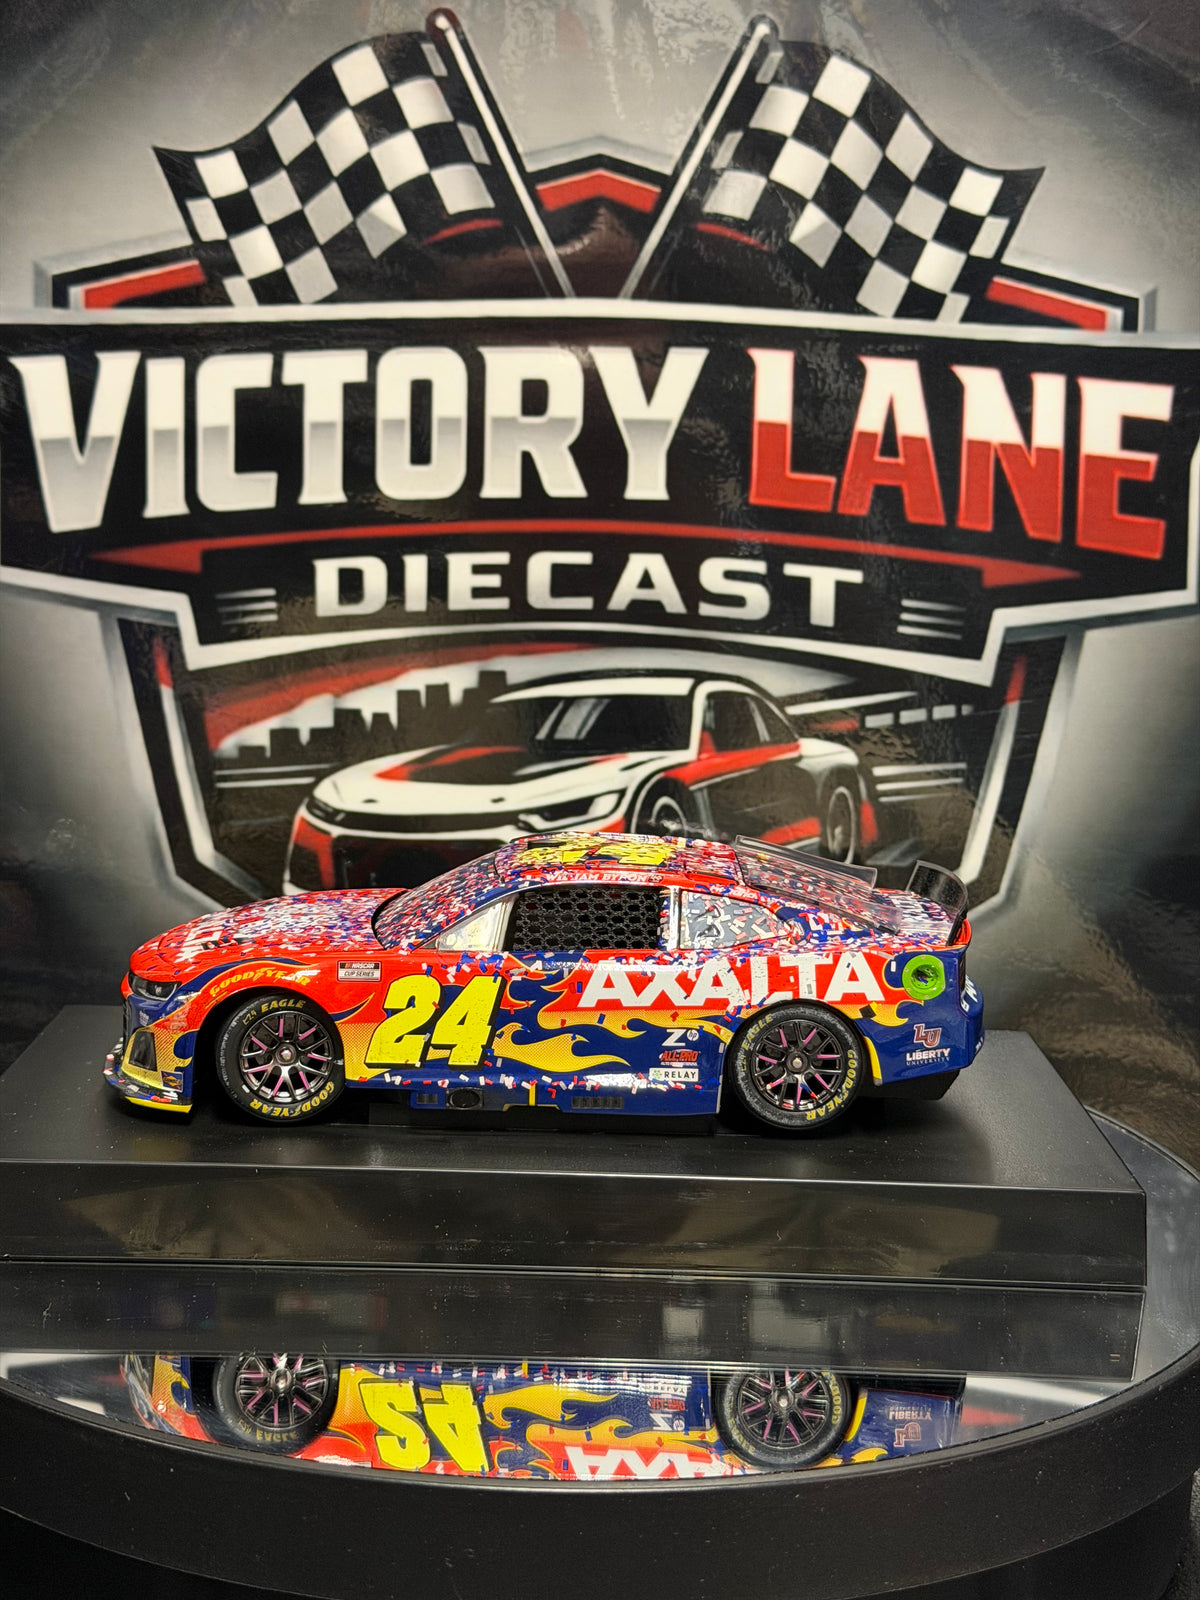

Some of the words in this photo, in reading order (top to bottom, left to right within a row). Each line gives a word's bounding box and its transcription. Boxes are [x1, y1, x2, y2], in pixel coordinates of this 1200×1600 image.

[8, 346, 709, 533] VICTORY
[748, 348, 1174, 560] LANE
[313, 550, 863, 628] DIECAST
[577, 951, 886, 1008] AXALTA
[261, 998, 306, 1013] EAGLE
[364, 974, 505, 1068] 24
[661, 1028, 687, 1046] Z
[742, 1013, 773, 1050] EAGLE
[914, 1023, 942, 1048] LU
[660, 1050, 699, 1062] ALL-PRO
[906, 1048, 951, 1062] LIBERTY
[664, 1070, 696, 1079] RELAY
[806, 1049, 857, 1121] GOODYEAR
[249, 1081, 335, 1117] GOODYEAR
